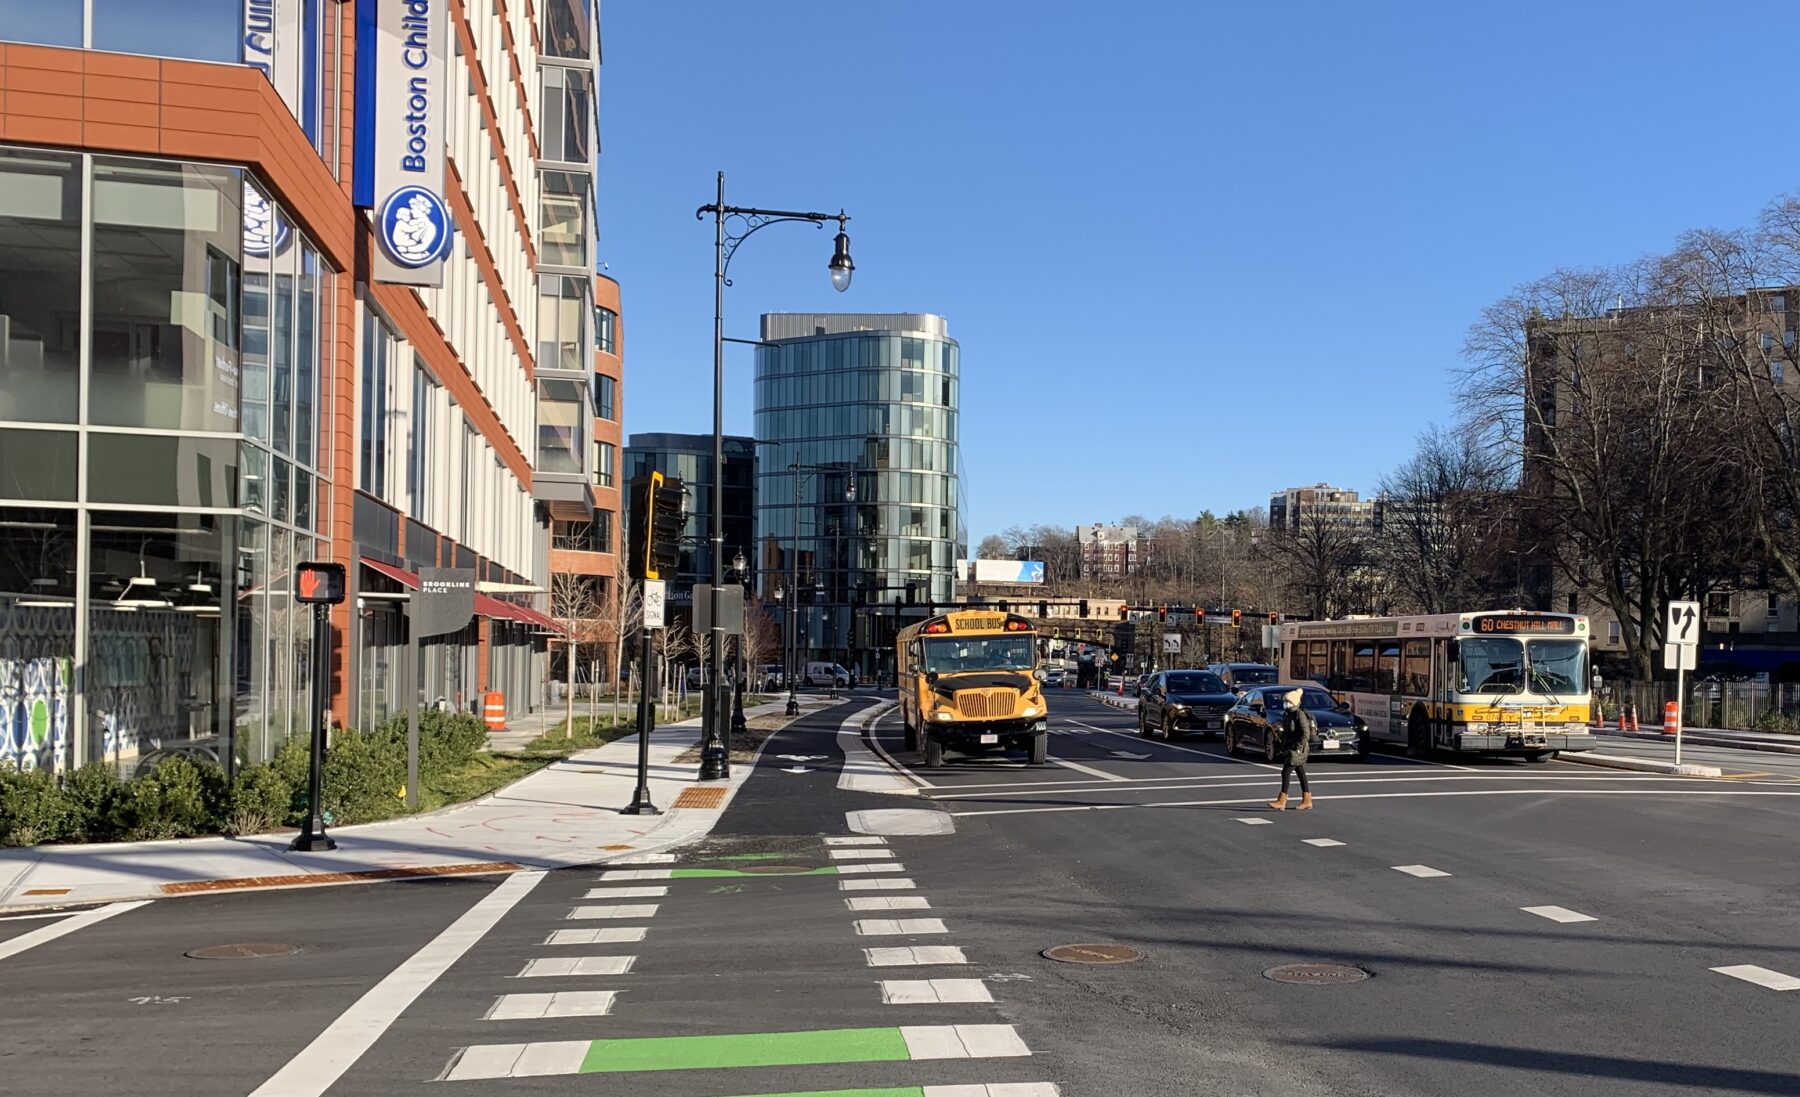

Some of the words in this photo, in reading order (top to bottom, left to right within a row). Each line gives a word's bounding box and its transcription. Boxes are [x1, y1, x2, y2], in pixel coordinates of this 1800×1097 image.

[402, 0, 429, 70] Child
[402, 77, 427, 173] Boston
[646, 610, 662, 620] SIGNAL
[955, 618, 984, 630] SCHOOL
[987, 617, 1001, 629] BUS
[1481, 618, 1494, 632] 60
[1496, 620, 1529, 630] CHESTNUT
[1530, 620, 1546, 630] HILL
